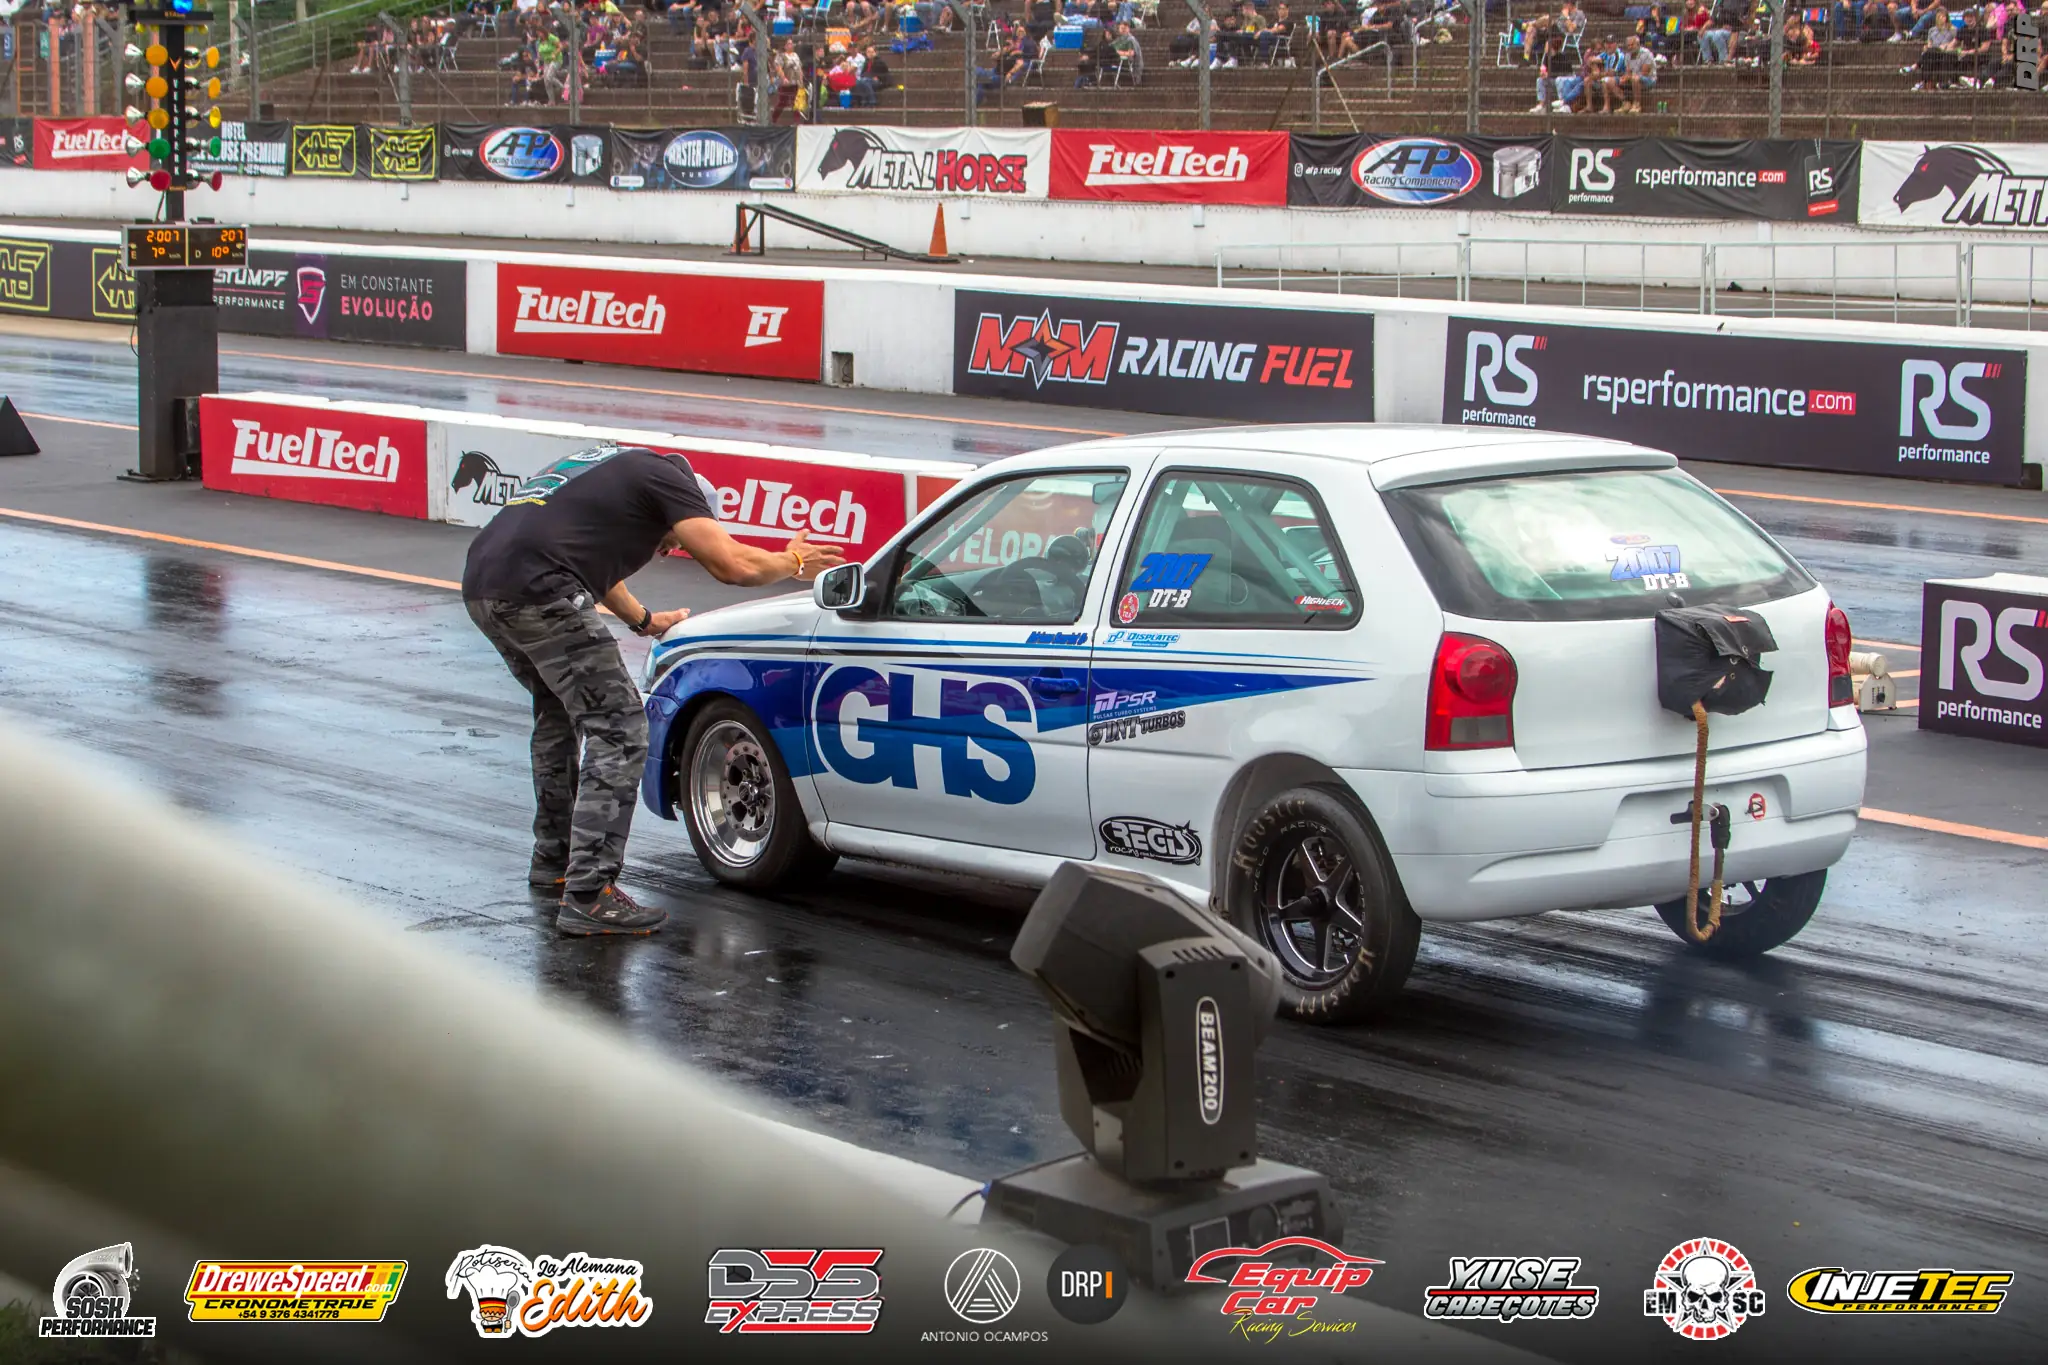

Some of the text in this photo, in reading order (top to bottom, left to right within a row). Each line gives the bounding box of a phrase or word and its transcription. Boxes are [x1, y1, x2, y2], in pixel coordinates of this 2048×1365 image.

[240, 142, 286, 164] PREMIUM
[704, 140, 734, 168] POWER
[1086, 144, 1249, 183] FuelTech
[1363, 175, 1461, 187] Racing Components
[1569, 148, 1618, 191] RS
[1809, 167, 1833, 190] RS
[1568, 193, 1614, 204] performance
[221, 229, 243, 242] 207
[213, 268, 289, 287] STUMPF
[340, 274, 433, 294] EM CONSTANTE
[212, 295, 285, 310] PERFORMANCE
[340, 296, 433, 322] EVOLUÇÃO
[515, 286, 666, 334] FuelTech
[746, 305, 789, 340] FT
[1118, 336, 1257, 382] RACING
[1260, 345, 1354, 389] FUEL
[1464, 330, 1540, 407] RS
[1899, 359, 1993, 441] RS
[1462, 408, 1536, 427] performance
[231, 419, 400, 483] FuelTech
[1898, 443, 1991, 464] performance
[717, 478, 867, 544] elTech
[1128, 552, 1214, 592] 2007
[1641, 573, 1690, 591] DT-B
[1148, 589, 1192, 608] DT-B
[1938, 599, 2045, 702] RS
[1115, 690, 1156, 709] PSR
[1134, 705, 1157, 714] SYSTEMS
[1140, 710, 1186, 735] TURBOS
[1938, 700, 2043, 729] performance
[815, 666, 1037, 805] GHS
[1111, 821, 1191, 857] REGIS
[1200, 1012, 1219, 1111] BEAM200
